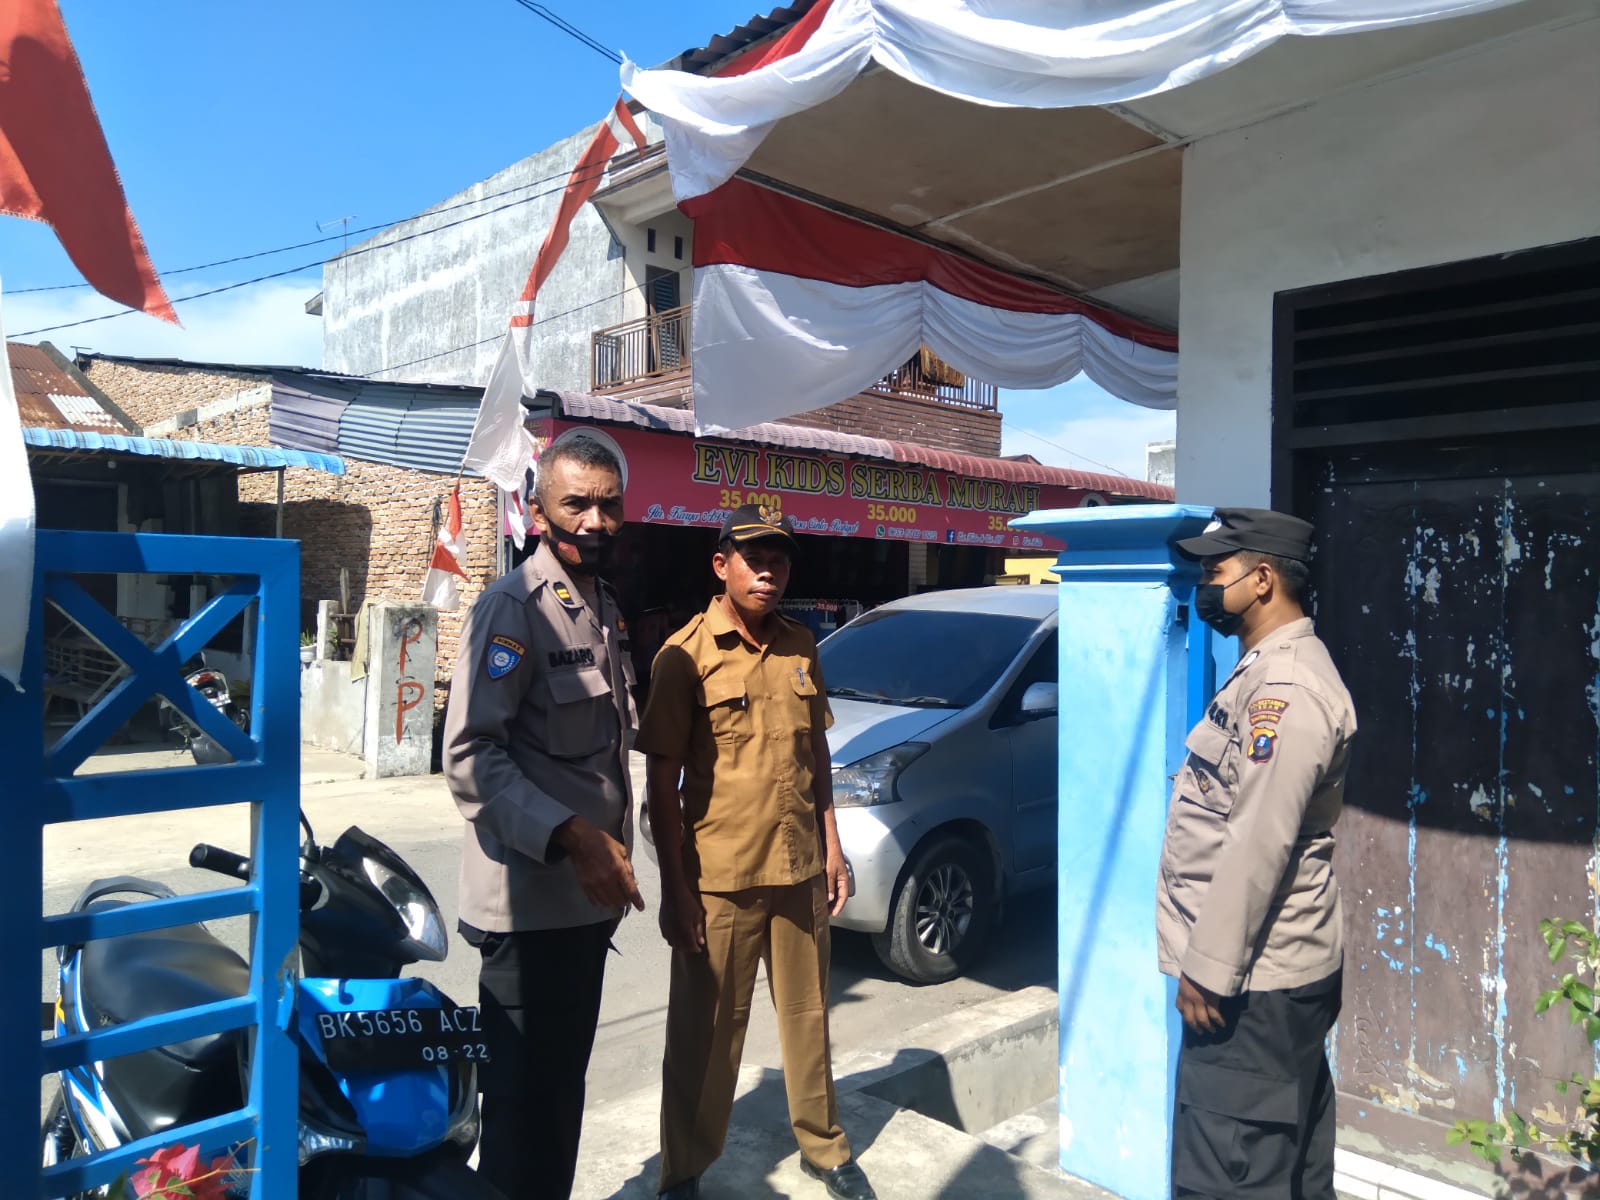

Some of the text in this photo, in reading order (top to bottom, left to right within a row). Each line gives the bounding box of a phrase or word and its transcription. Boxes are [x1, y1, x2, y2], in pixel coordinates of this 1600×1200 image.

[692, 443, 1041, 514] EVI KIDS SERBA MURAH
[867, 503, 917, 524] 35.000
[318, 1008, 482, 1039] BK 5656 ACZ
